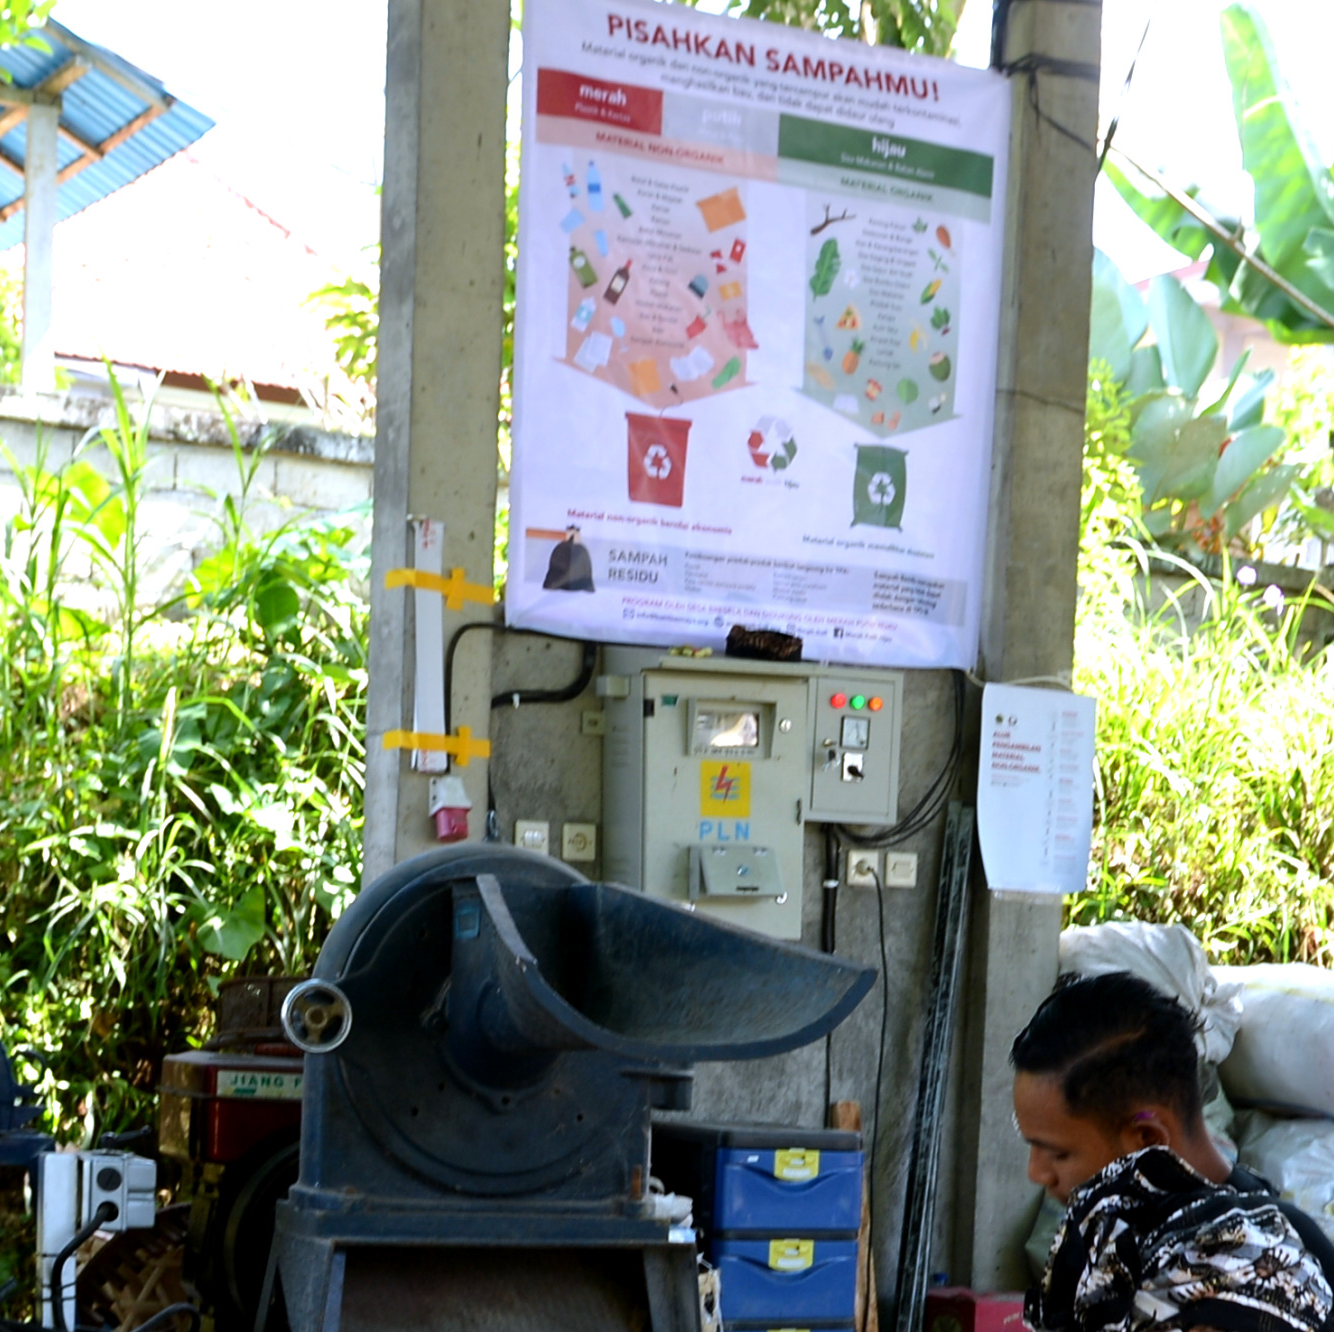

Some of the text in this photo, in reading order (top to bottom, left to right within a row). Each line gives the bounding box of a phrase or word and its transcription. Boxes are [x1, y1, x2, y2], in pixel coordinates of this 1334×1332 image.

[607, 13, 939, 102] PISAHKAN SAMPAHMU!
[579, 83, 627, 107] merah
[702, 108, 741, 127] putih
[596, 131, 644, 151] MATERIAL
[871, 136, 907, 159] hijau
[840, 176, 934, 203] MATERIAL ORGANIK
[608, 548, 667, 567] SAMPAH
[608, 567, 659, 584] RESIDU
[699, 820, 750, 841] PLN
[230, 1075, 285, 1088] JIANG
